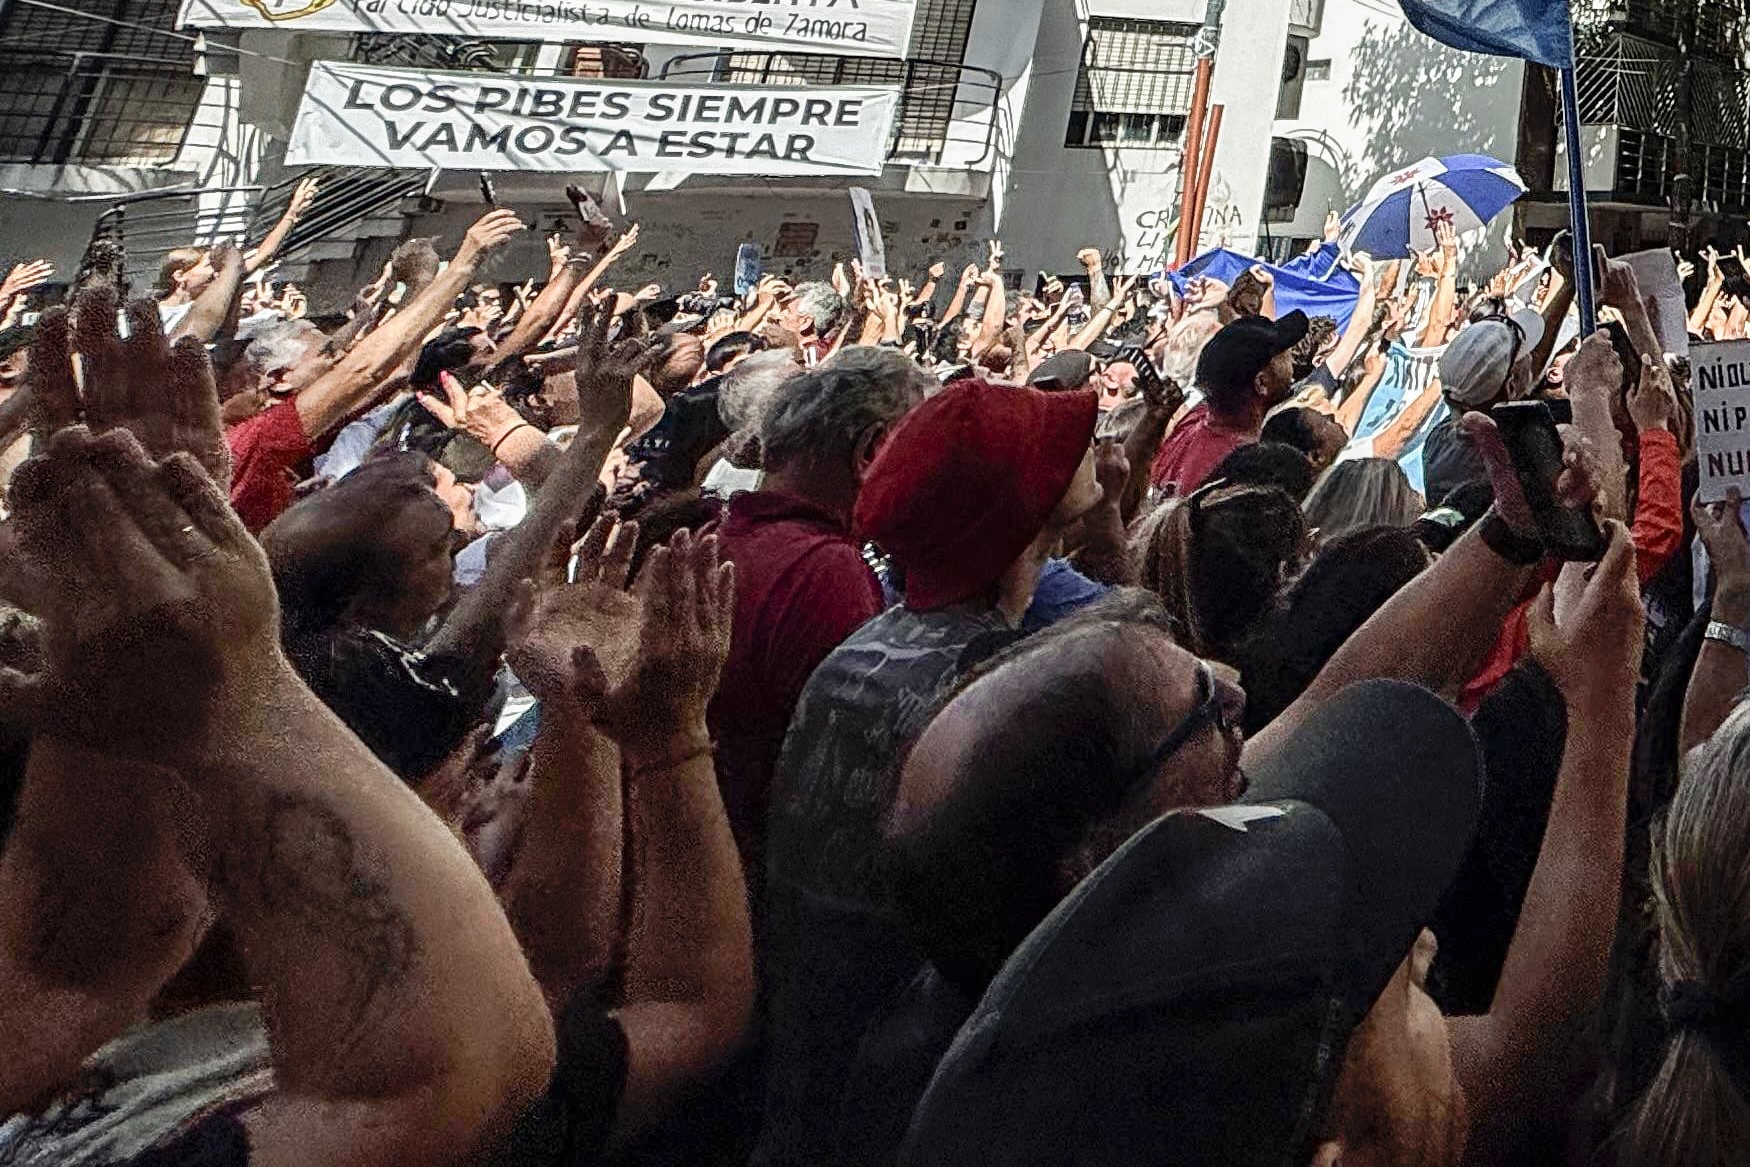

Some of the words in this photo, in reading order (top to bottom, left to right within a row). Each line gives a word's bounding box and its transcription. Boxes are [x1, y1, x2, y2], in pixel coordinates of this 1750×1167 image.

[624, 5, 650, 27] de
[666, 6, 735, 34] Lomas
[745, 10, 772, 35] de
[782, 13, 868, 42] Zamora
[343, 78, 459, 113] LOS
[473, 87, 634, 120] PIBES
[642, 91, 863, 128] SIEMPRE
[385, 120, 589, 156] VAMOS
[599, 129, 638, 157] A
[657, 129, 817, 163] ESTAR
